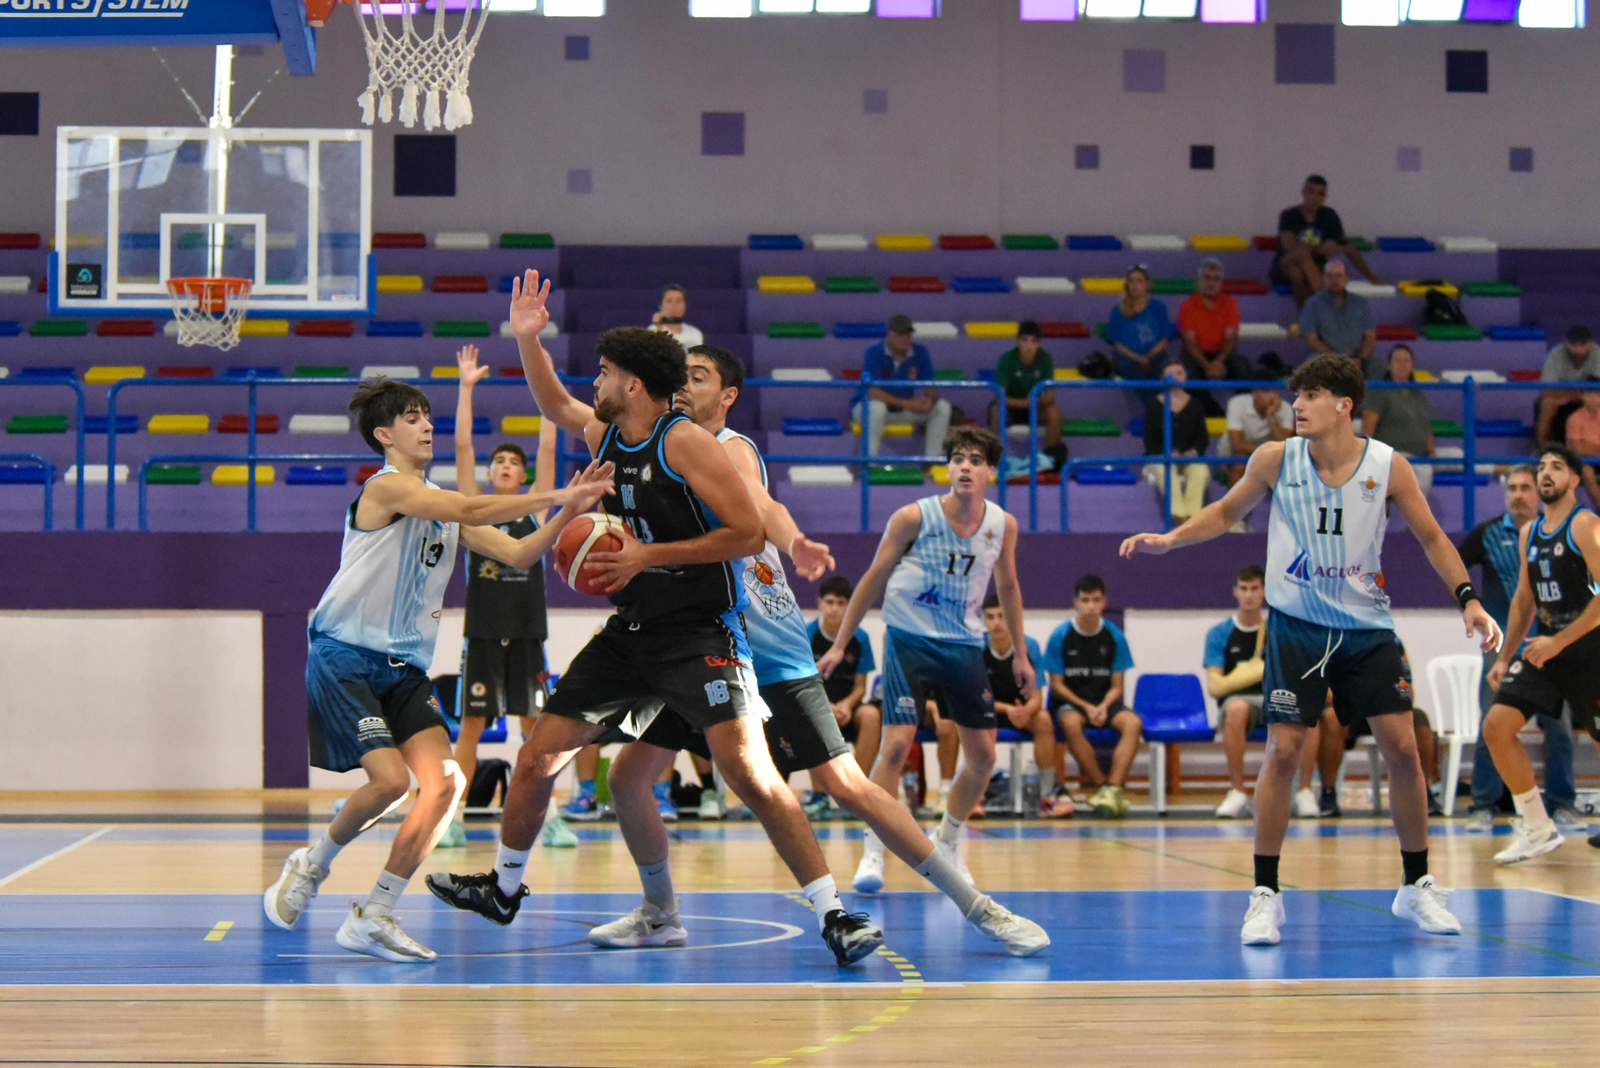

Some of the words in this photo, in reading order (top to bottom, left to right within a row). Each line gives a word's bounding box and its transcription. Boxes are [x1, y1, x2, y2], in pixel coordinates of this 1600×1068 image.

[622, 466, 638, 475] vive
[1316, 507, 1343, 536] 11
[420, 536, 444, 568] 13
[945, 553, 976, 576] 17
[1536, 580, 1563, 603] ULB
[704, 679, 731, 707] 18
